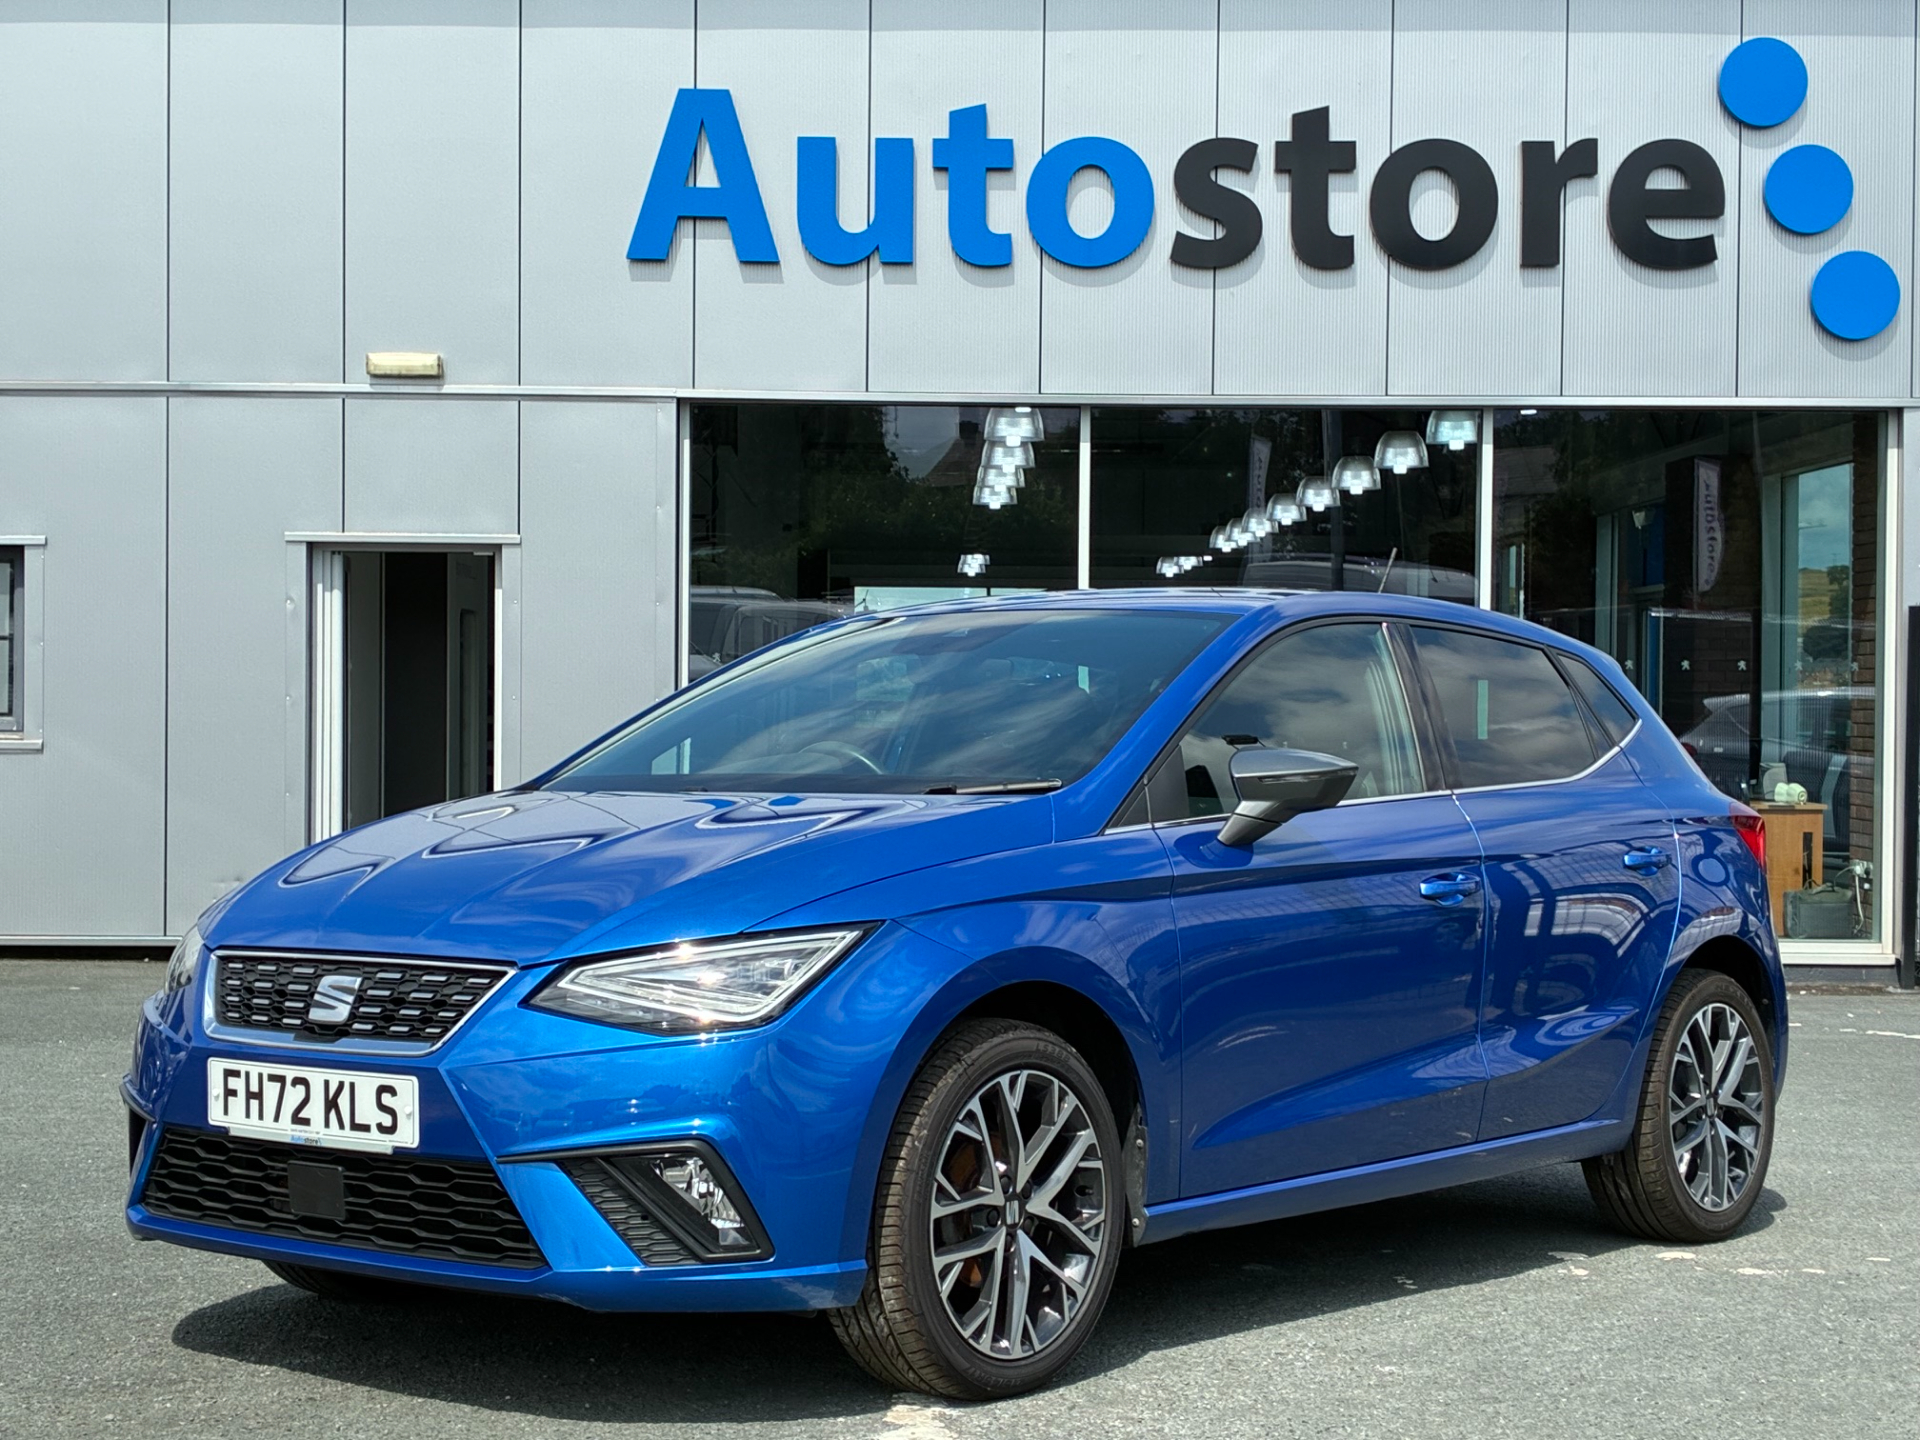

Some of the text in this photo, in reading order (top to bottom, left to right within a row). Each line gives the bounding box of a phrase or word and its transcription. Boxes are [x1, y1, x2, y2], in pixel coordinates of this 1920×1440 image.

[626, 88, 1725, 270] Autostore
[223, 1068, 398, 1135] FH72 KLS
